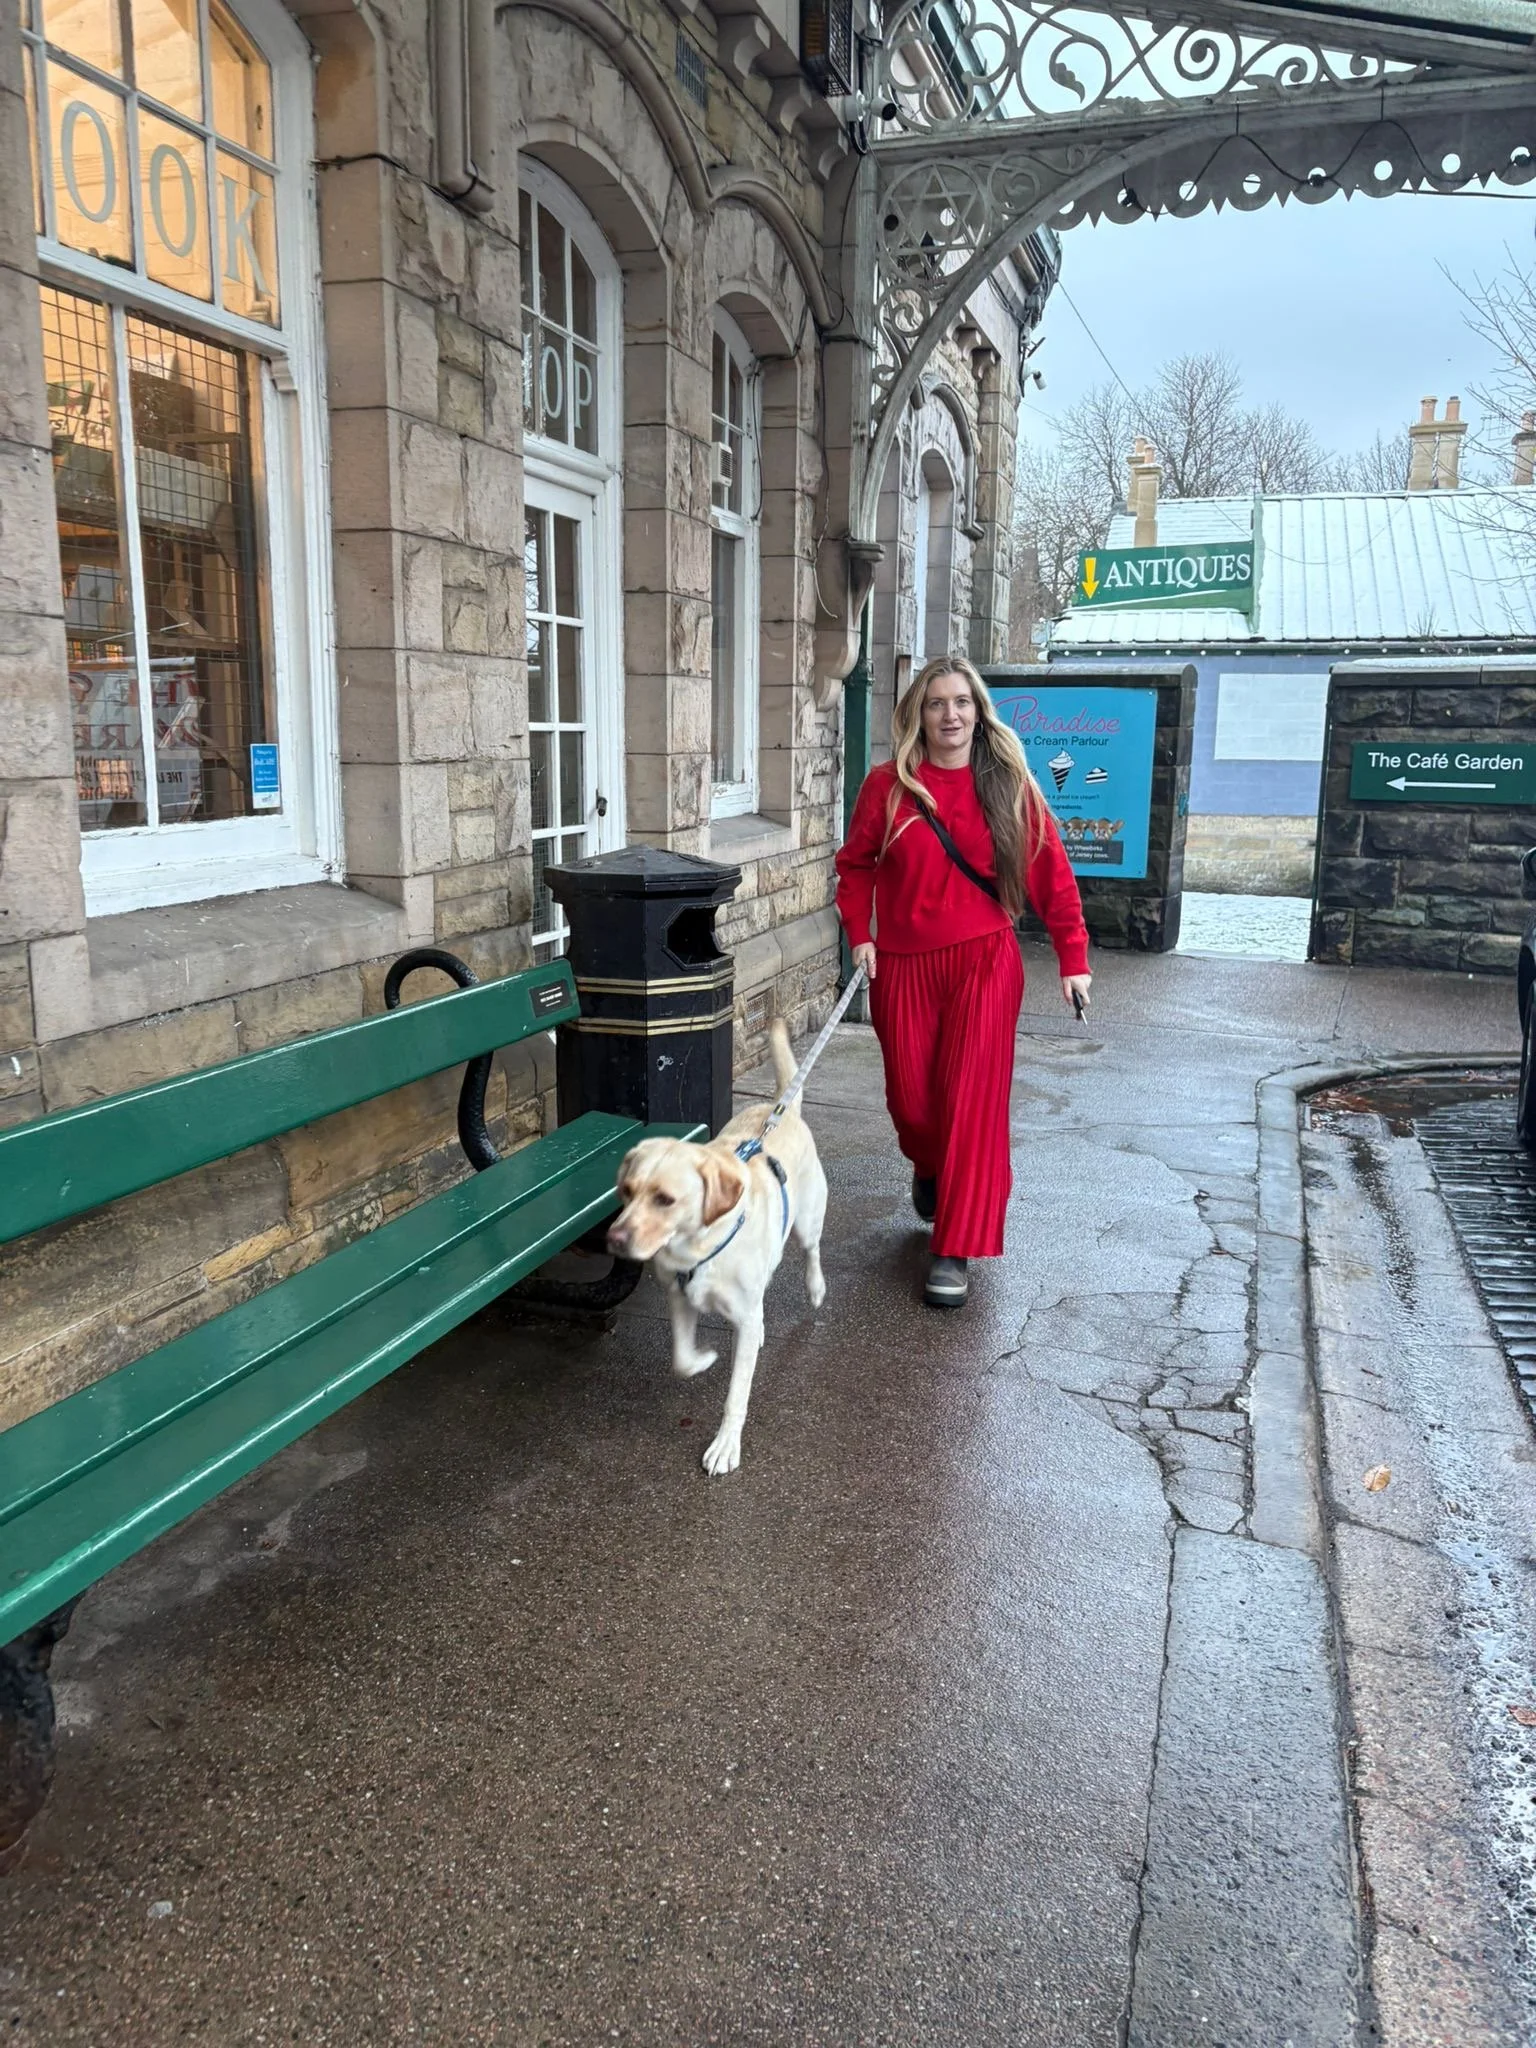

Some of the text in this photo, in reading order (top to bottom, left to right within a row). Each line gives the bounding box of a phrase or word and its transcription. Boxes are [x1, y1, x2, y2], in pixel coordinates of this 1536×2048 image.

[61, 99, 275, 297] OOK
[521, 332, 592, 430] OP
[1103, 553, 1251, 588] ANTIQUES
[995, 695, 1121, 734] Paradise
[1034, 736, 1068, 746] Cream
[1071, 736, 1110, 746] Parlour
[1368, 752, 1524, 770] The Café Garden
